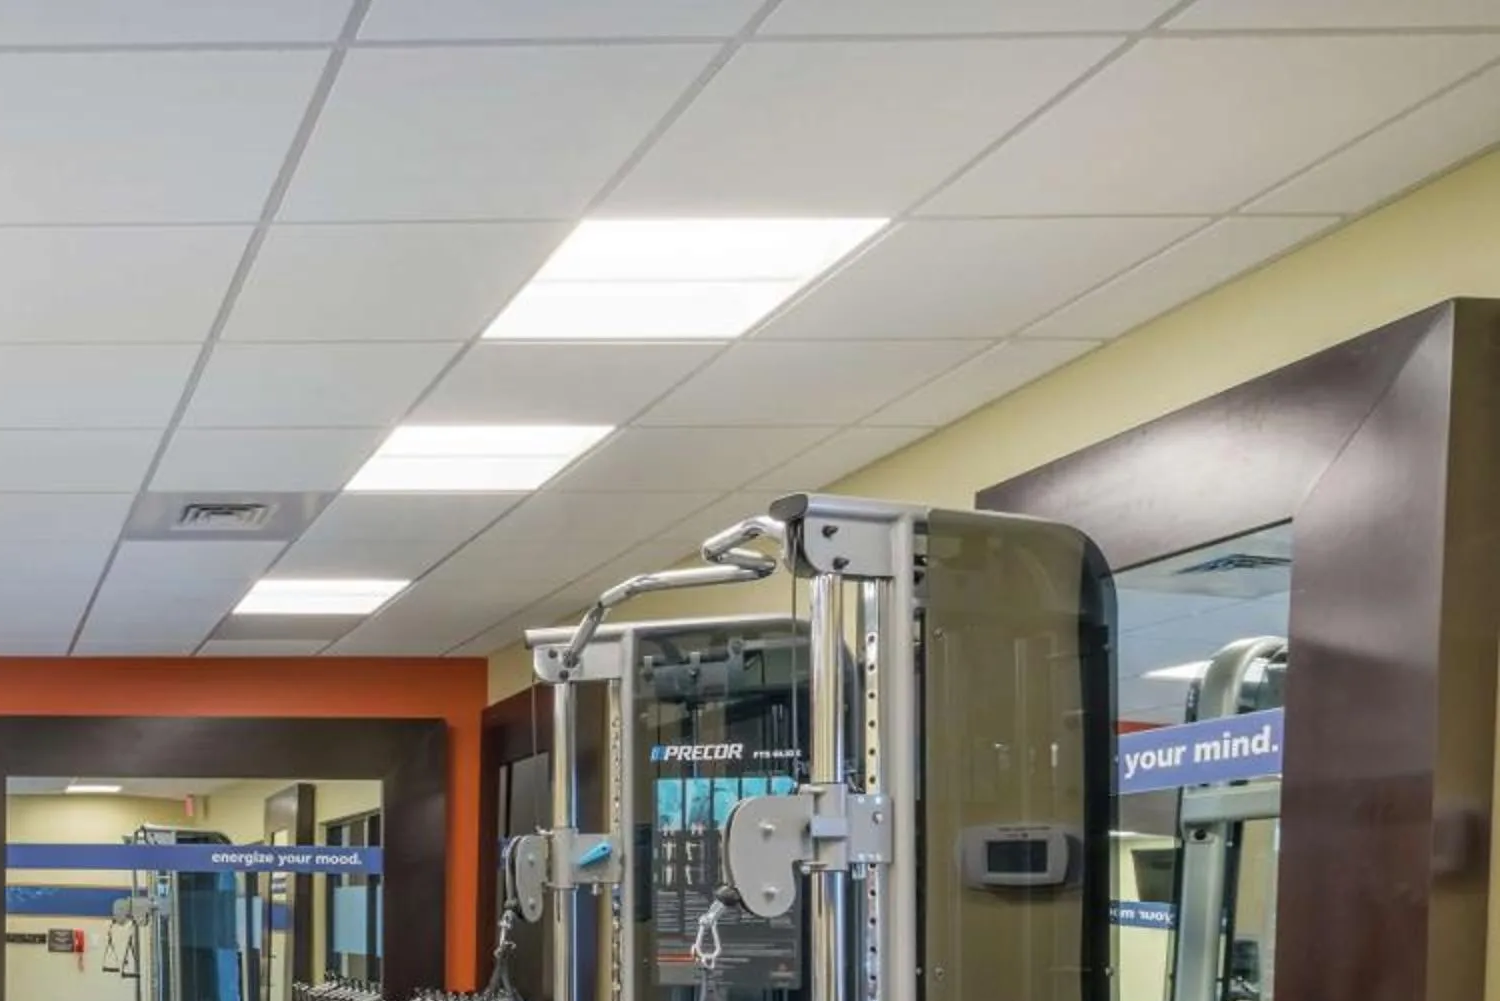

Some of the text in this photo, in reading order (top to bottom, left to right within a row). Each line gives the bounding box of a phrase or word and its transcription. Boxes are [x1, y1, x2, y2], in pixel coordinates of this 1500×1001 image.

[663, 743, 743, 761] PRECOR
[1124, 724, 1279, 780] your mind.
[211, 850, 362, 867] energize your mood.
